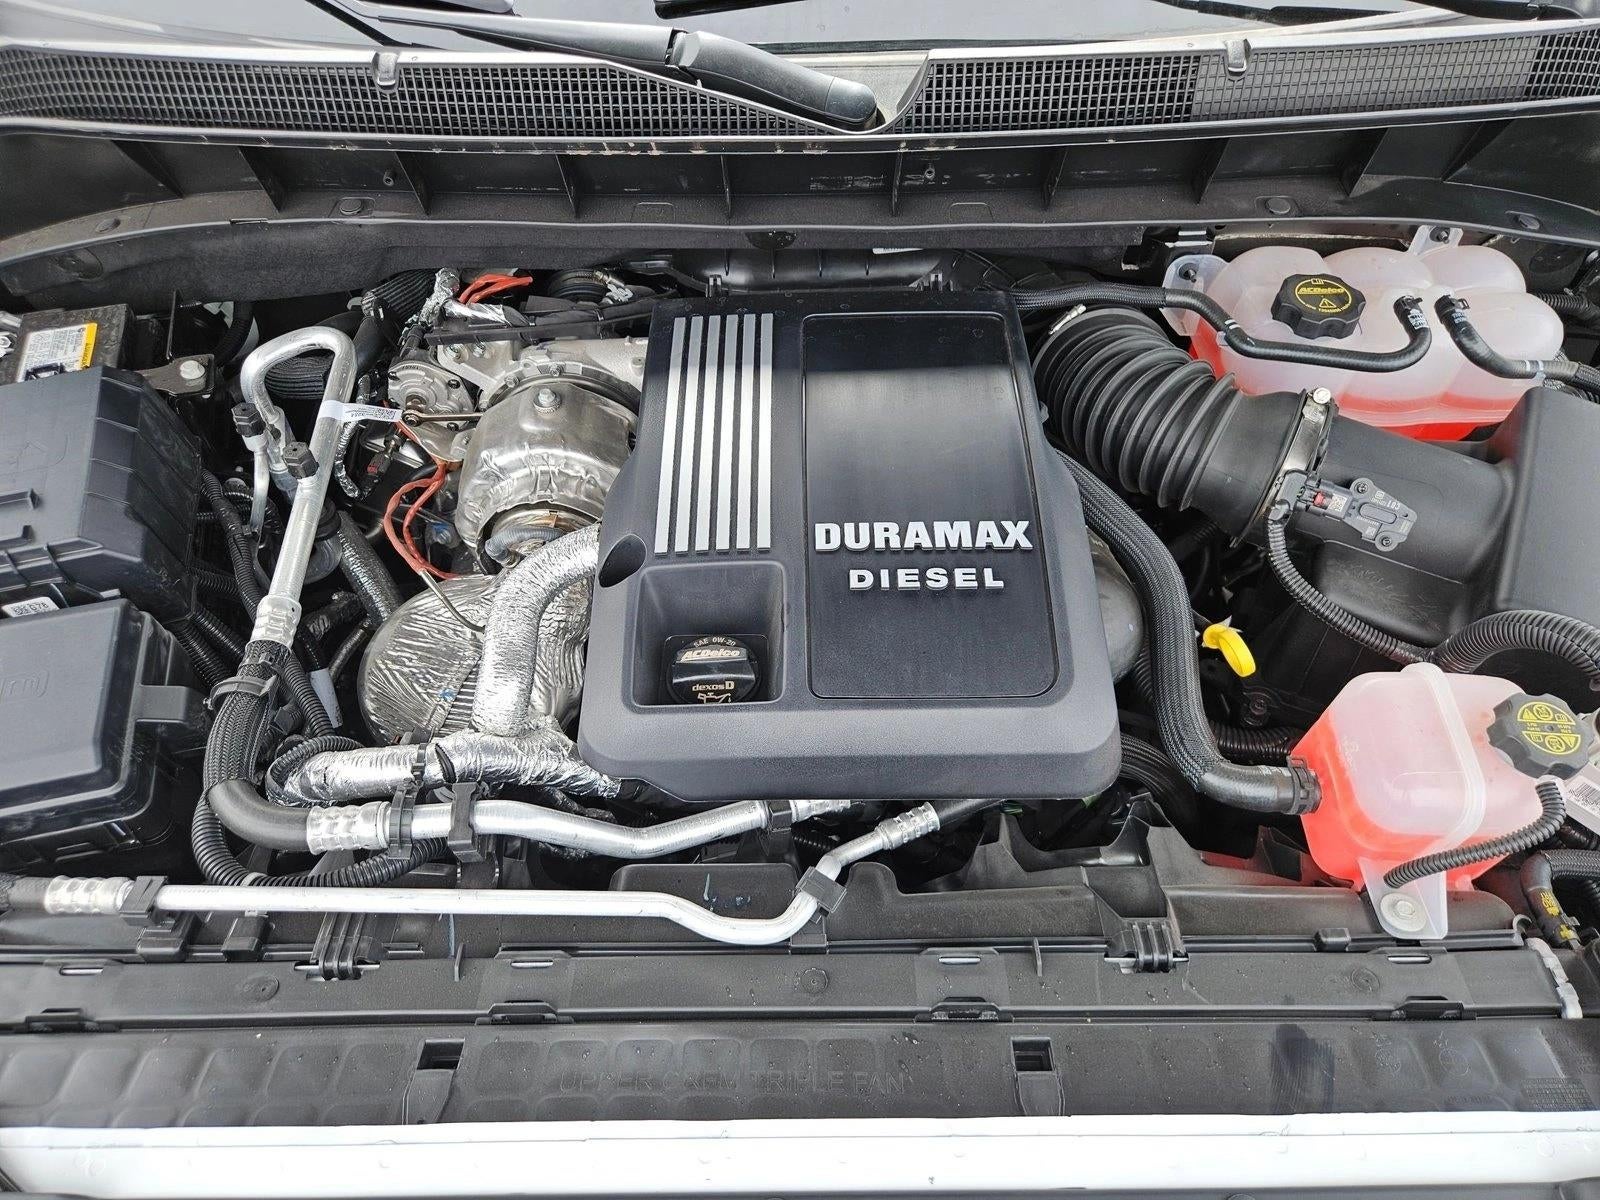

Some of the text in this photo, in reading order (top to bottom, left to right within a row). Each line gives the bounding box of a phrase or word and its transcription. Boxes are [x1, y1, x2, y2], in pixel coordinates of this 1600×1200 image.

[815, 520, 1033, 552] DURAMAX
[849, 567, 1005, 591] DIESEL
[693, 636, 737, 648] SAE 0W-20
[681, 648, 741, 662] ACDelco
[853, 1071, 904, 1093] FAN
